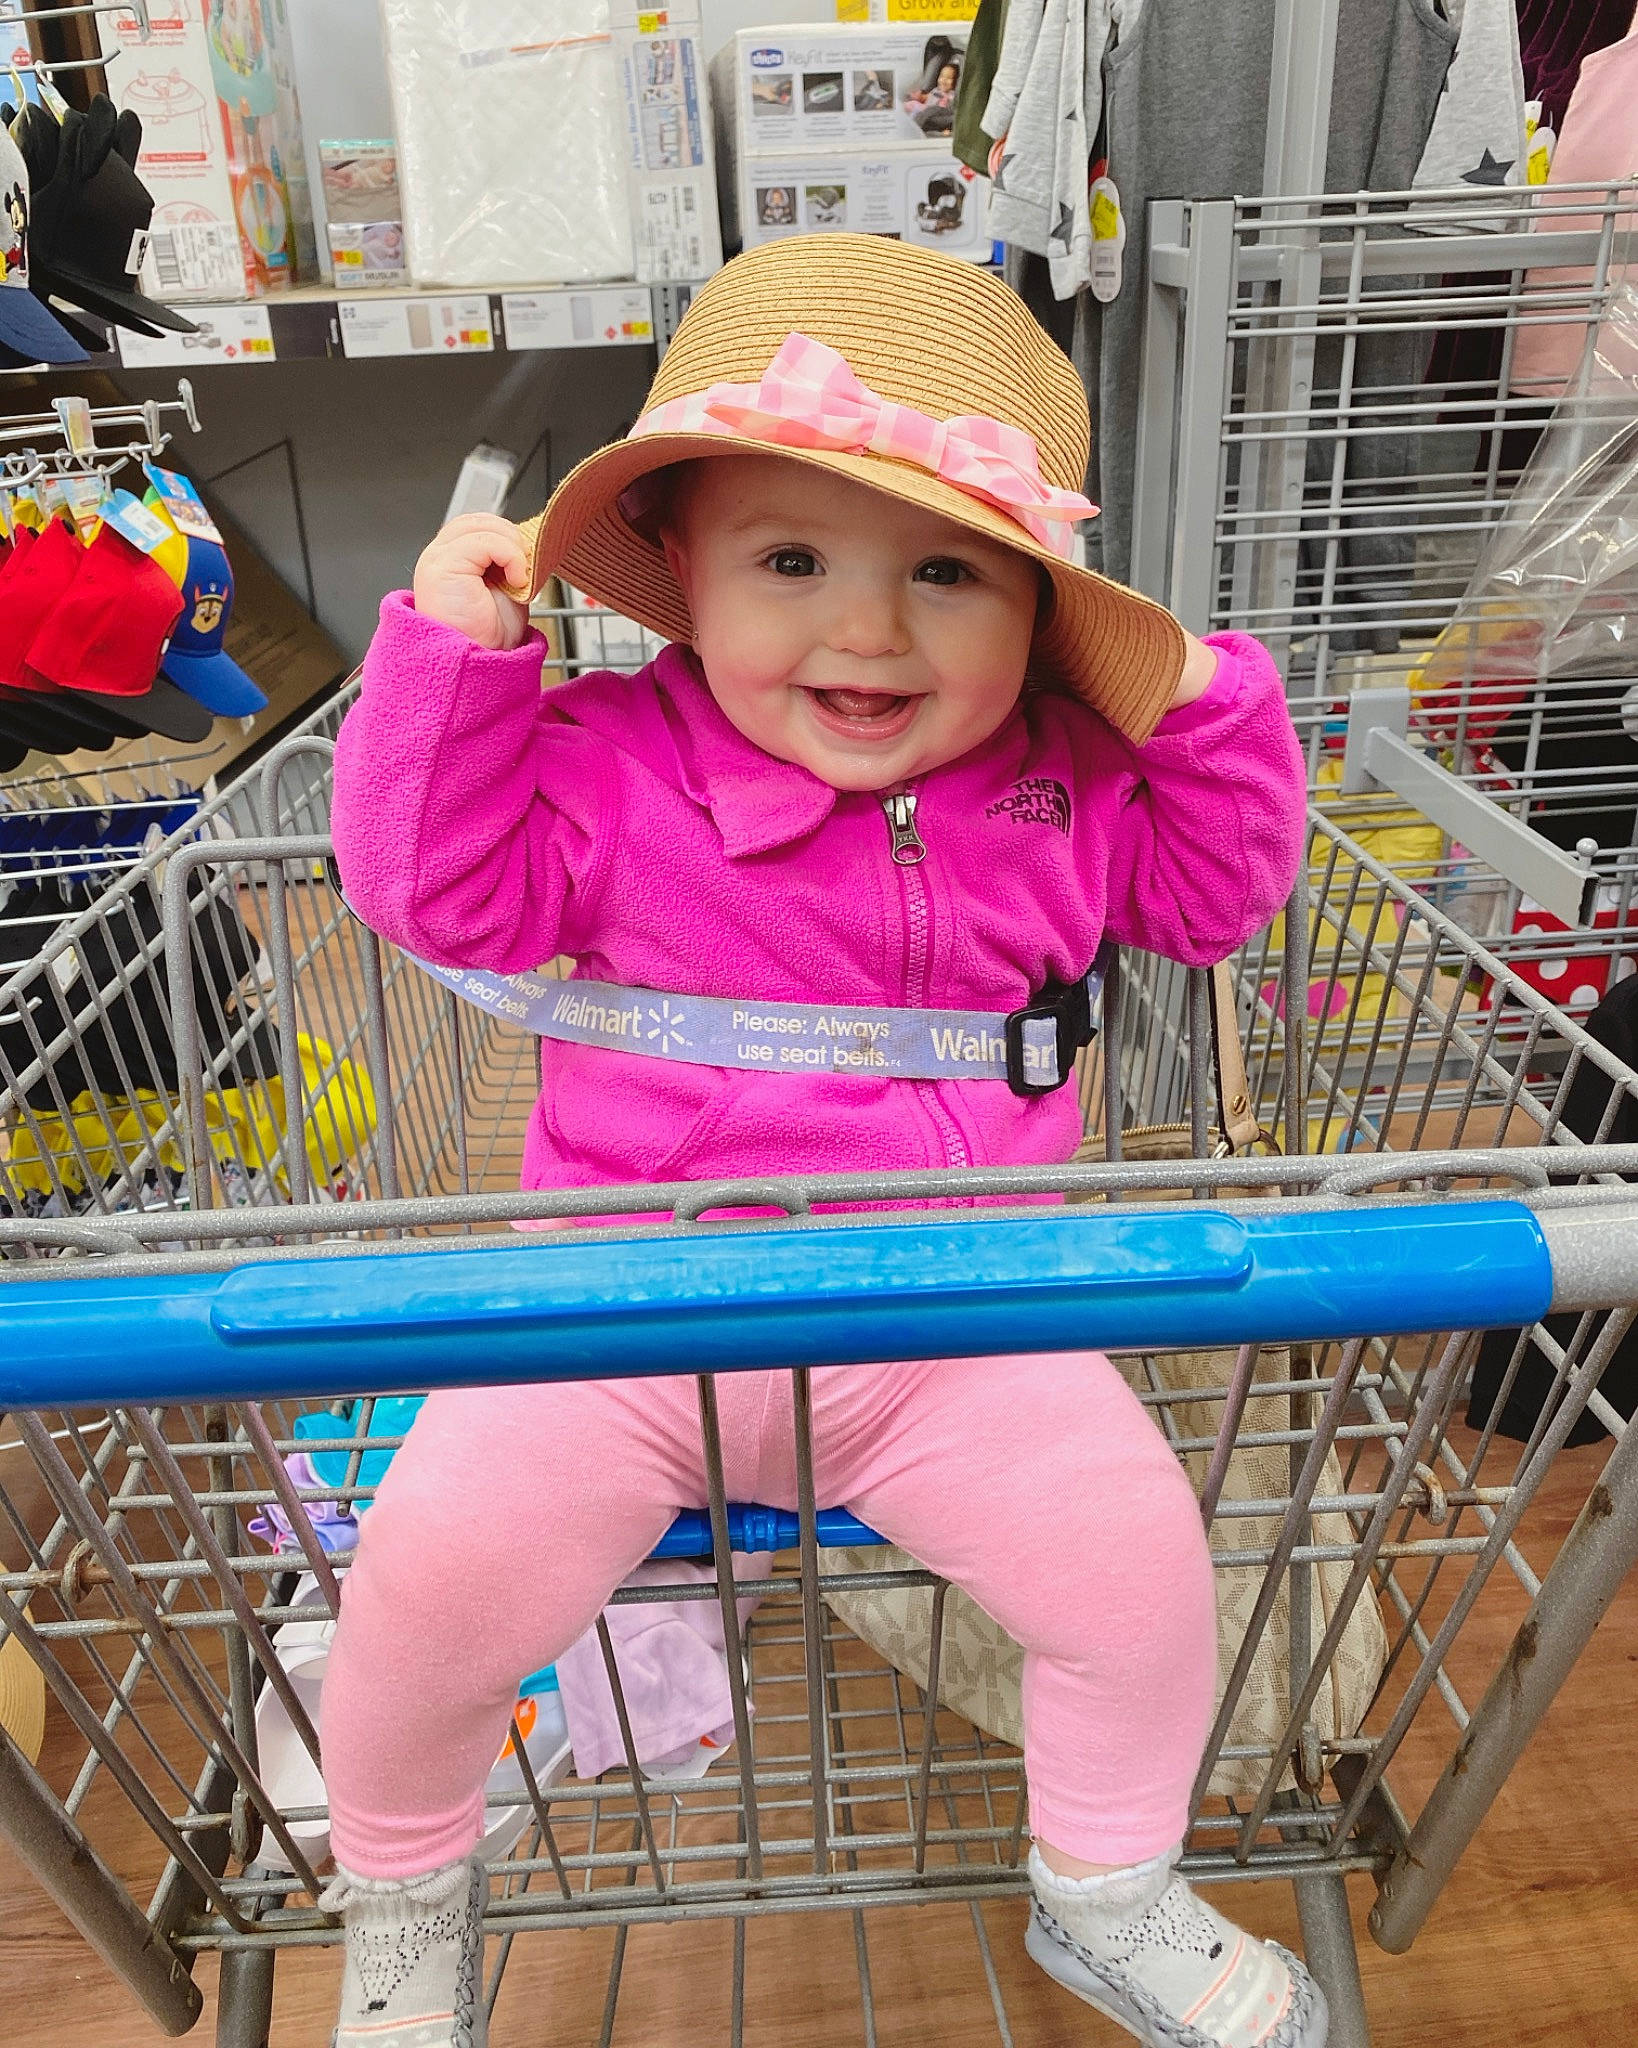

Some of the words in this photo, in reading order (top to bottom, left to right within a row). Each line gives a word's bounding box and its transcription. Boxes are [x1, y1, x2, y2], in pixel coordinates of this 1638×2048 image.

[1011, 778, 1054, 793] THE
[985, 793, 1058, 819] NORTH
[1010, 808, 1062, 830] FACE
[464, 977, 501, 1003] seat
[552, 993, 642, 1039] Walmart
[732, 1010, 807, 1035] Please:
[814, 1015, 890, 1042] Always
[737, 1043, 774, 1061] use
[779, 1044, 828, 1065] seat
